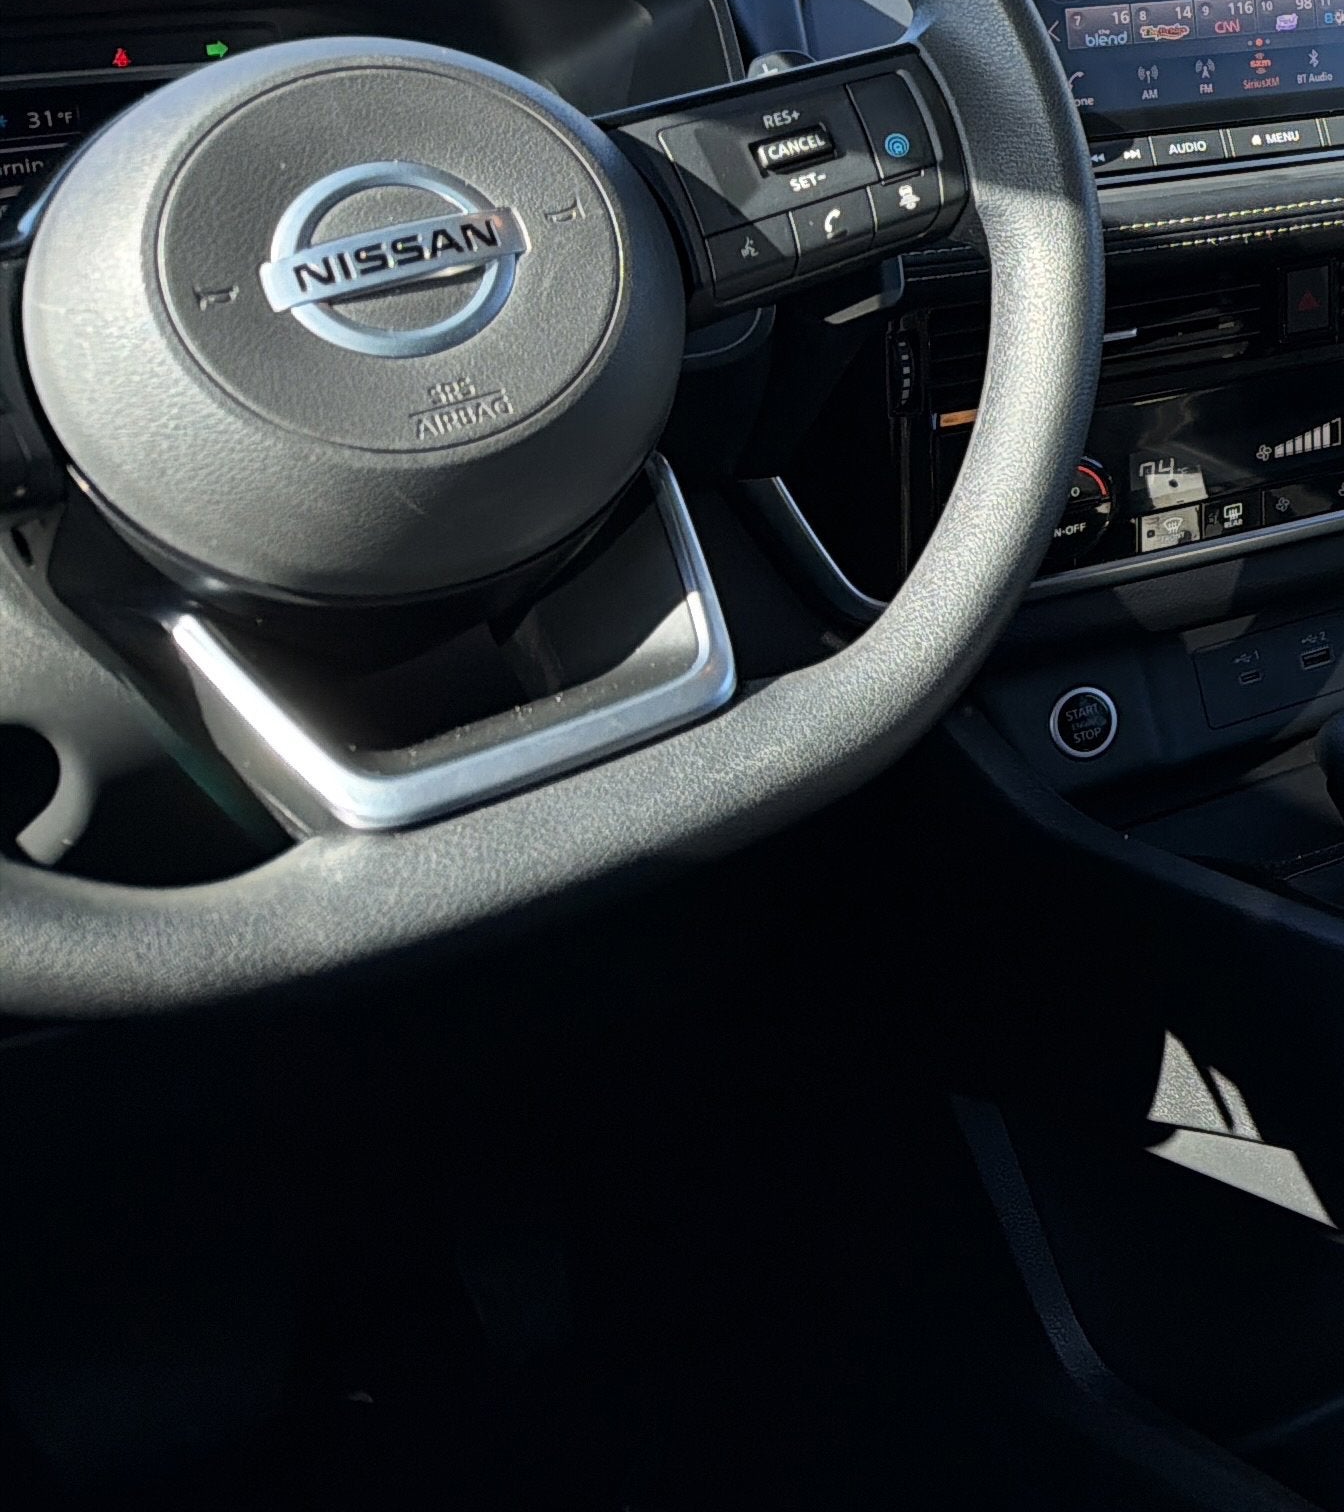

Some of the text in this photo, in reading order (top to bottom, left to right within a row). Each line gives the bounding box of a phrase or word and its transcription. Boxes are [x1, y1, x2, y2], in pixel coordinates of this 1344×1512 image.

[1202, 1, 1254, 16] 9 116
[1261, 0, 1273, 11] 10
[1073, 10, 1131, 27] 7 16
[1139, 6, 1193, 21] 8 14
[1214, 19, 1241, 33] CNN
[1085, 31, 1128, 47] blend
[1243, 76, 1280, 90] SiriusXM
[1308, 71, 1334, 84] Audio
[1142, 89, 1159, 101] AM
[1199, 83, 1213, 94] FM
[1075, 96, 1095, 107] one
[762, 109, 801, 130] RES+
[1265, 130, 1300, 144] MENU
[767, 134, 826, 161] CANCEL
[1168, 140, 1207, 156] AUDIO
[293, 218, 500, 294] NISSAN
[427, 375, 477, 406] SRS
[415, 387, 514, 440] AIRBAG
[1065, 703, 1098, 722] START
[1073, 727, 1101, 744] STOP
